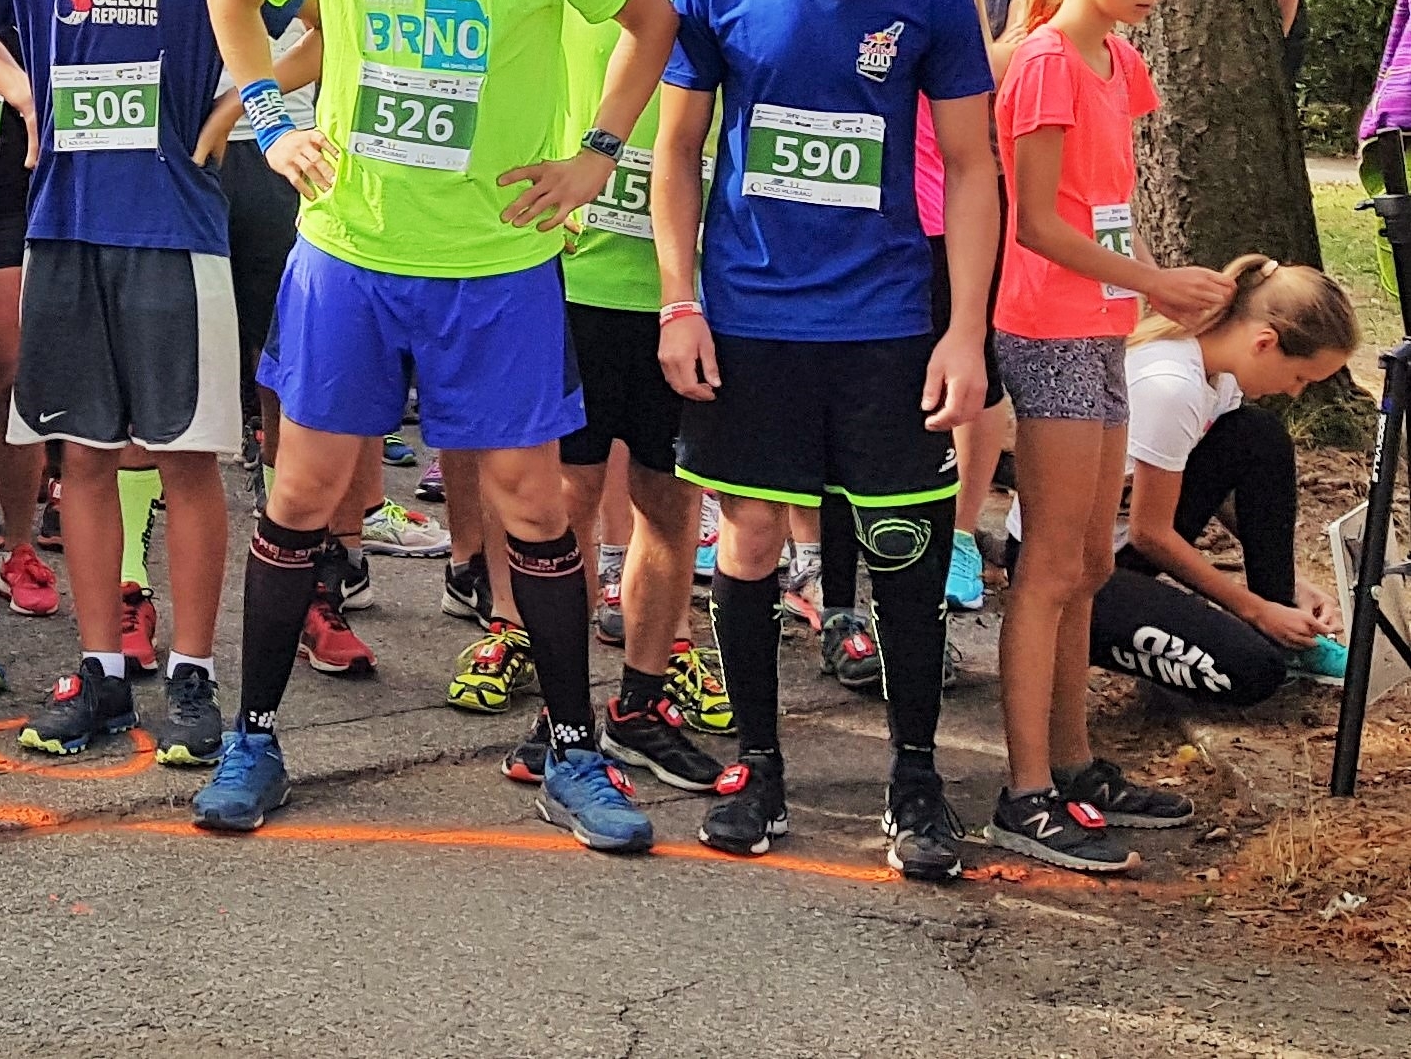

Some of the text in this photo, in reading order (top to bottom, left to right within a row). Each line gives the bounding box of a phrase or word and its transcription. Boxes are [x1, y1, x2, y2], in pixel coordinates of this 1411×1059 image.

[91, 7, 159, 26] REPUBLIC
[364, 12, 488, 60] BRNO
[857, 53, 891, 68] 400
[73, 89, 145, 127] 506
[374, 95, 454, 142] 526
[771, 135, 860, 180] 590
[597, 170, 647, 210] 15
